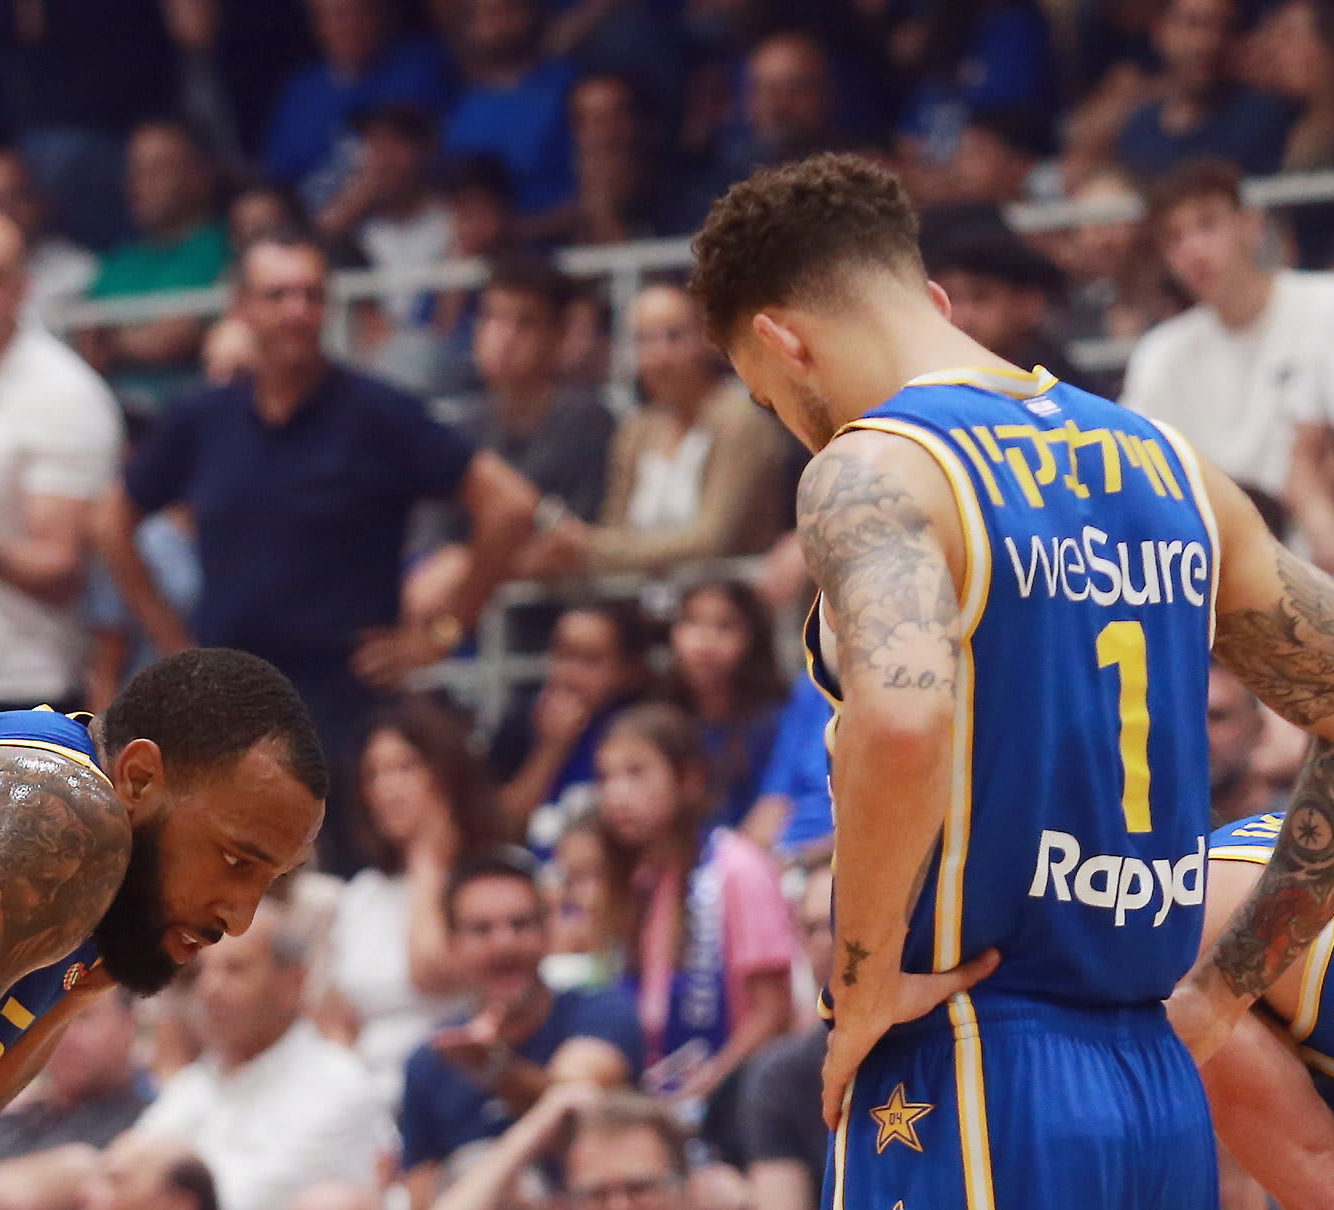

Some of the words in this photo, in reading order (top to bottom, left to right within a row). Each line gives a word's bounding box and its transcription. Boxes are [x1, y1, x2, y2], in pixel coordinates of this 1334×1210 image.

[1004, 525, 1208, 606] weSure
[1095, 620, 1153, 834] 1
[1028, 828, 1206, 928] Rapyd
[889, 1111, 903, 1126] 04
